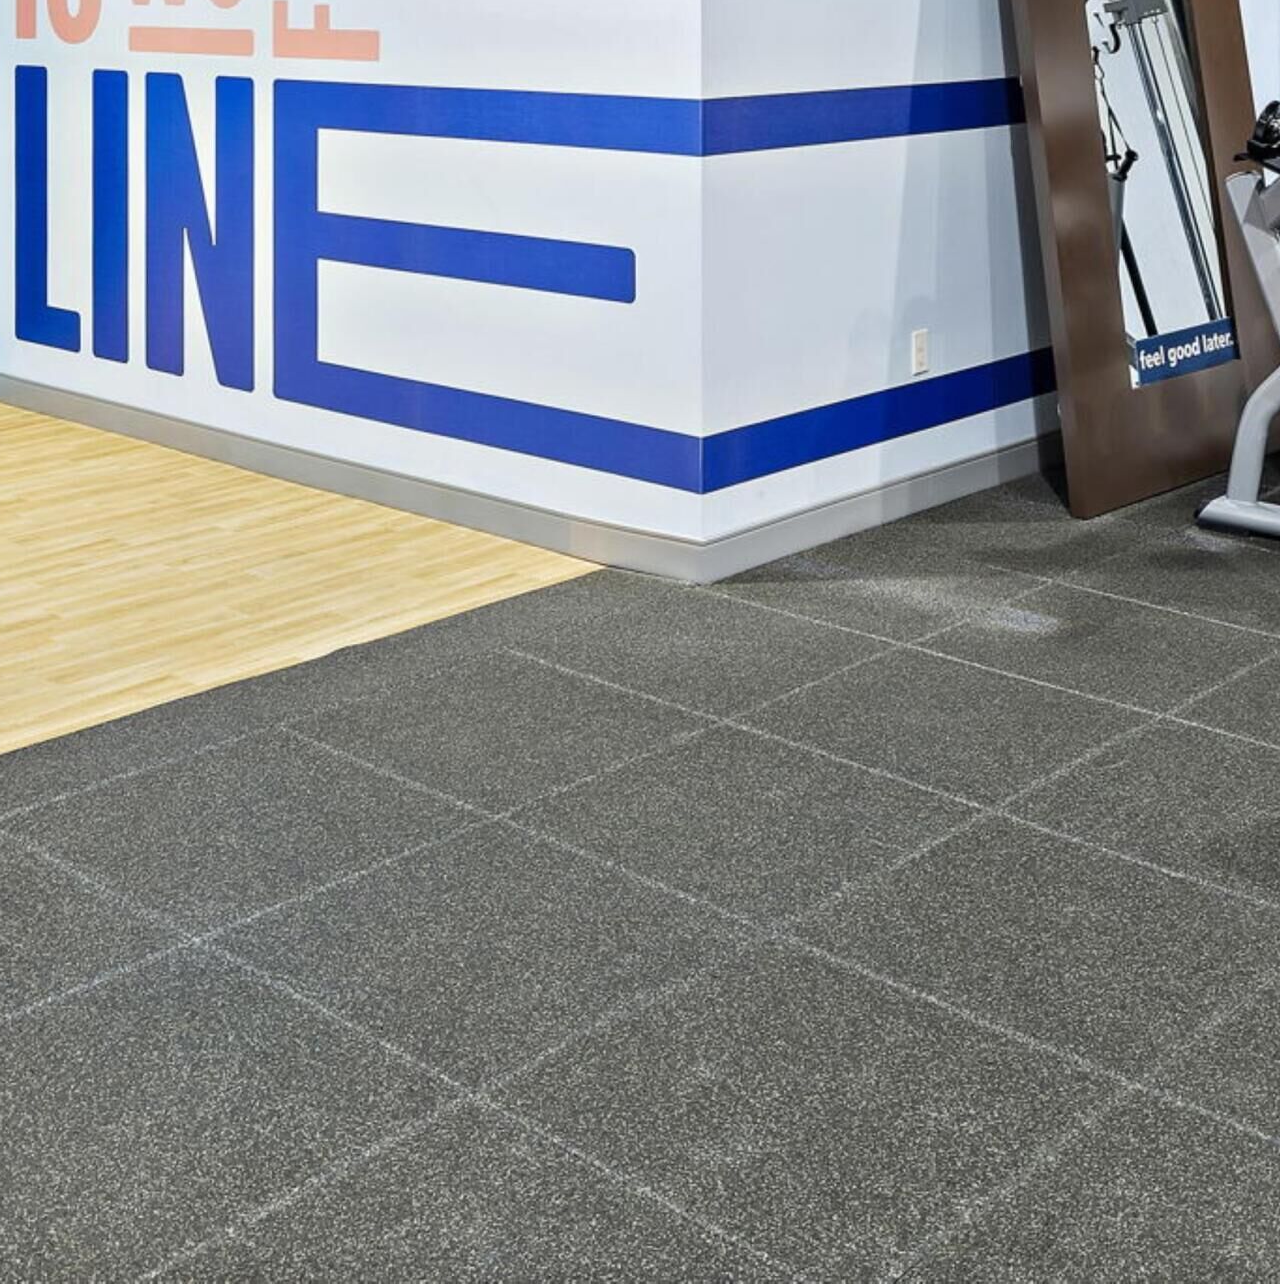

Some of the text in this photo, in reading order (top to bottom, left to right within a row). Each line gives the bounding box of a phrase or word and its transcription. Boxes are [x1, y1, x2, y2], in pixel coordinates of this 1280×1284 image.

[14, 64, 703, 495] LINE
[1139, 331, 1234, 371] feel good later.
